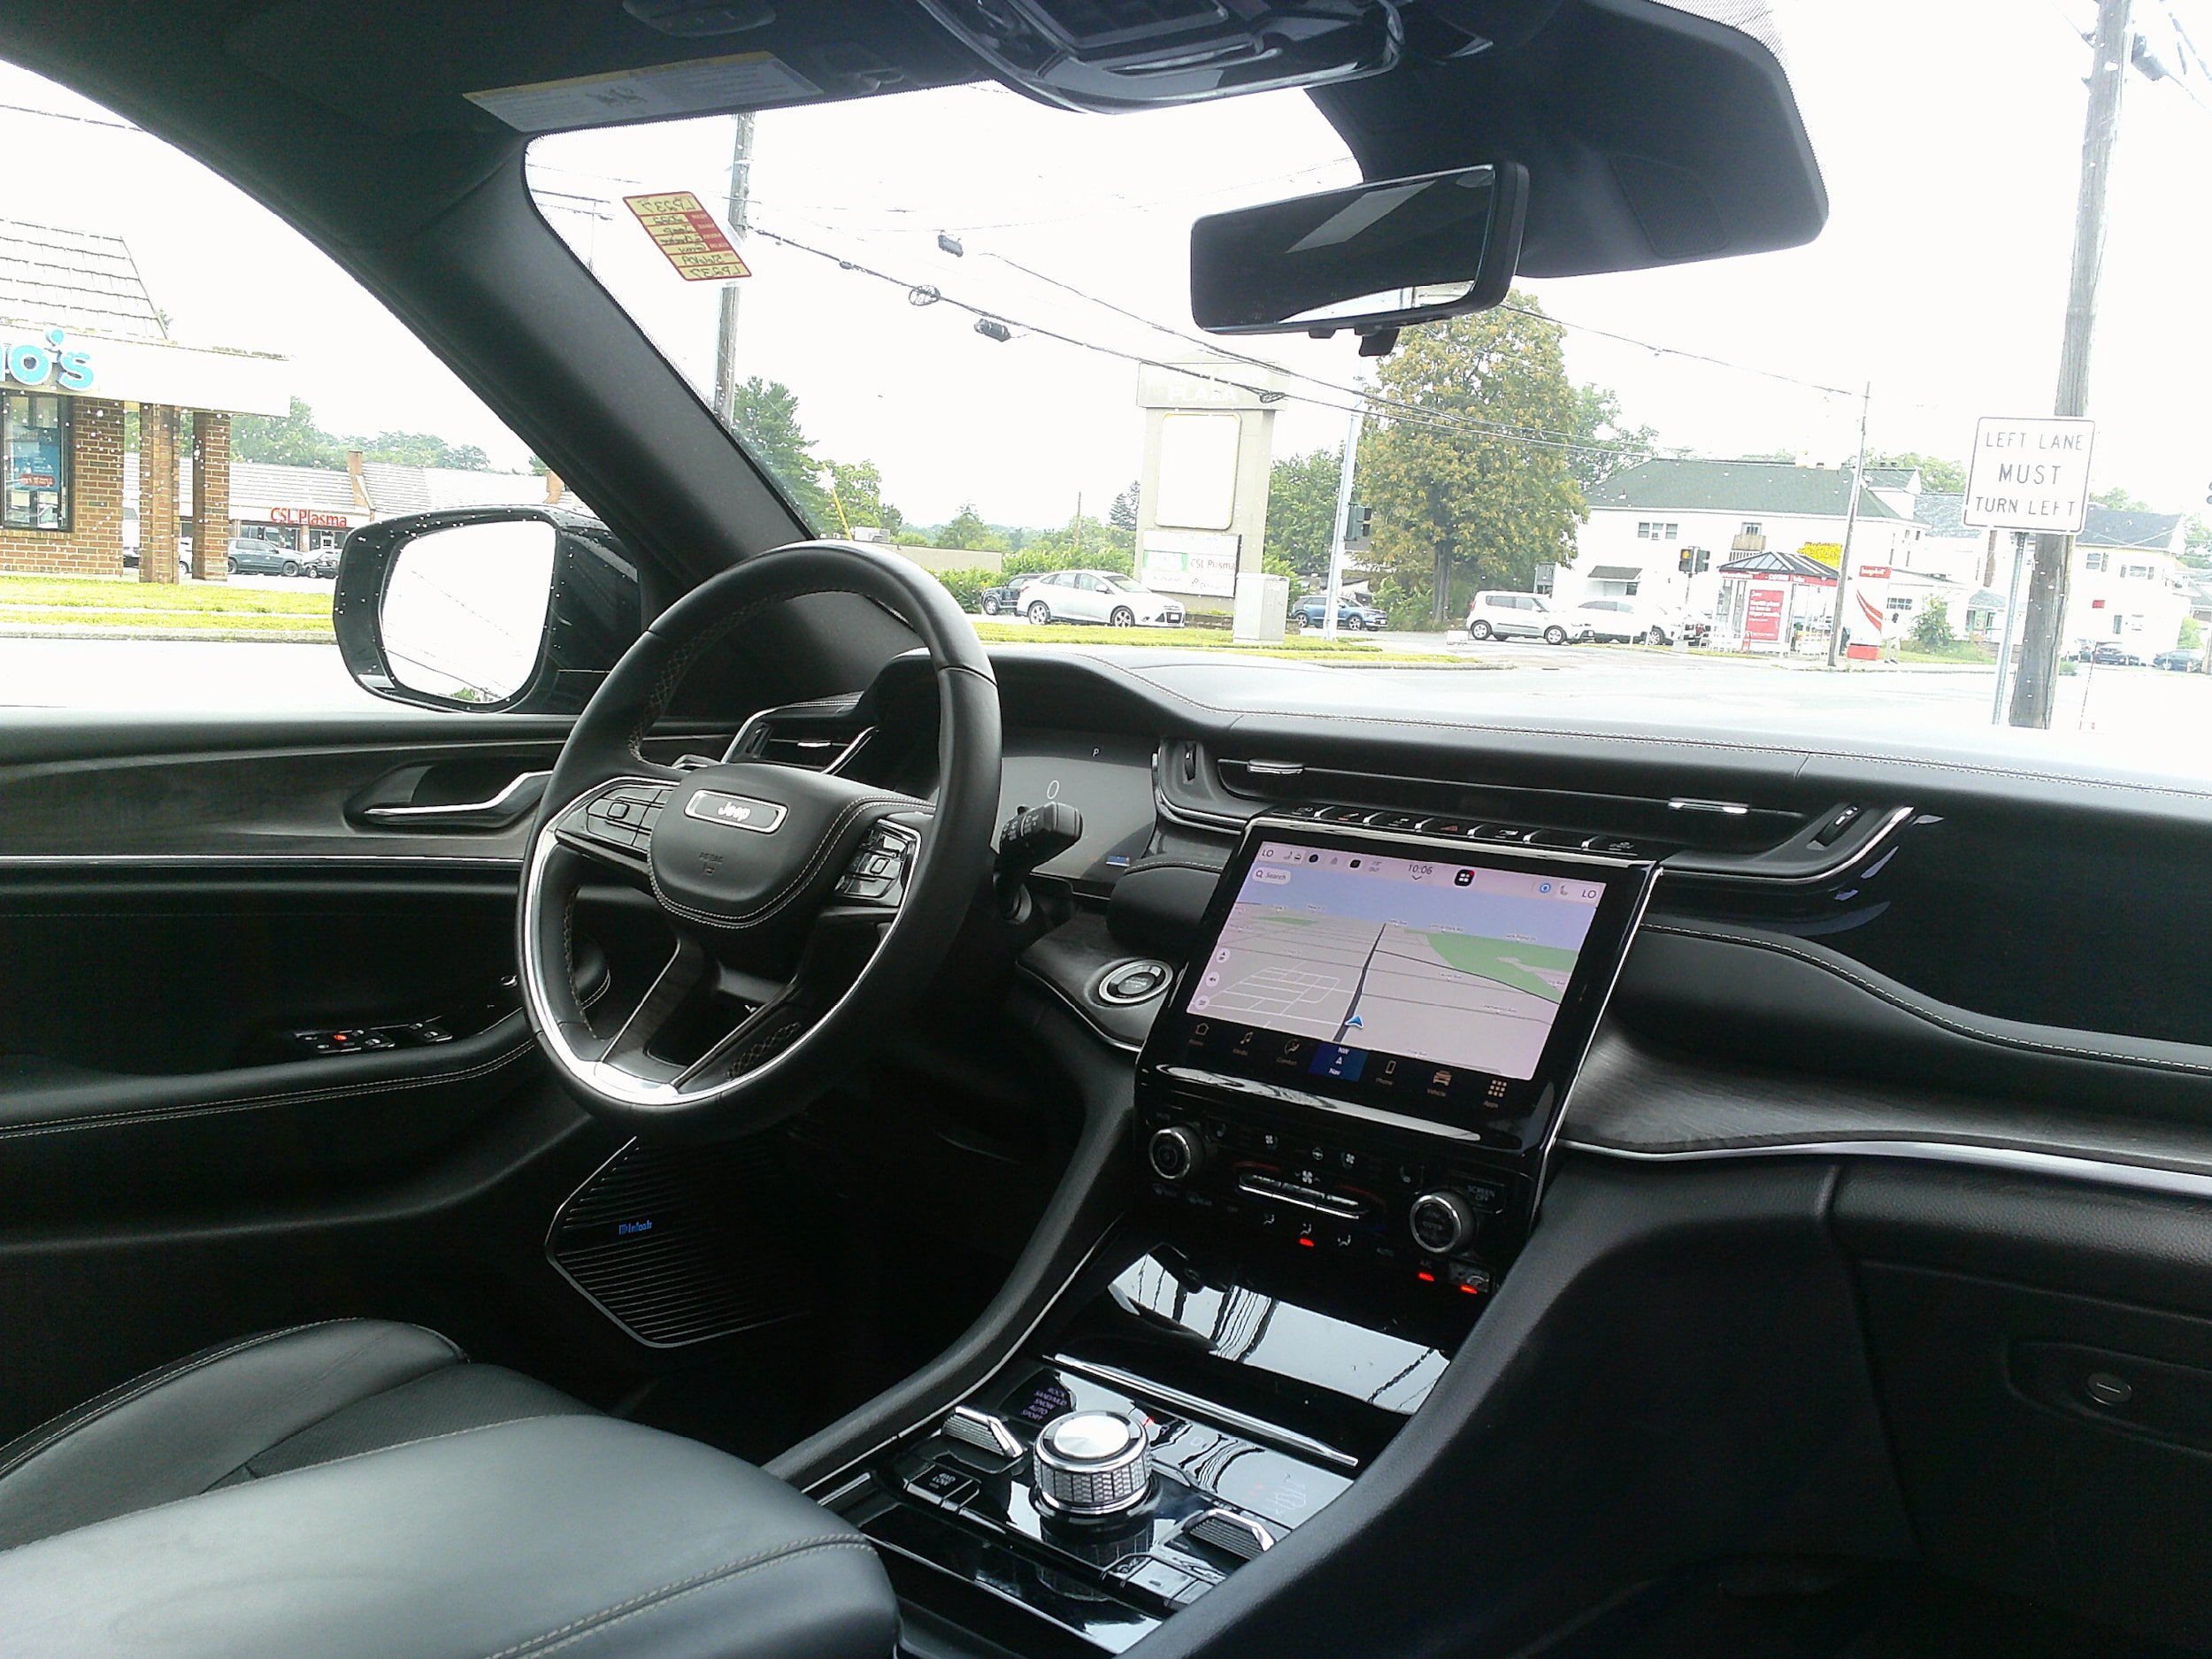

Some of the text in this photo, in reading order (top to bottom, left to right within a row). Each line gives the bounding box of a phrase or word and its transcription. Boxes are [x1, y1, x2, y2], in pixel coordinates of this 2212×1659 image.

[0, 328, 95, 391] o's
[1985, 432, 2085, 450] LEFT LANE
[1998, 463, 2062, 485] MUST
[1975, 496, 2077, 516] TURN LEFT
[270, 507, 348, 527] CSL Plasma
[718, 801, 751, 821] Jeep
[1261, 849, 1274, 857] LO
[1265, 872, 1286, 880] Search
[1581, 889, 1597, 899] LO
[1328, 1067, 1341, 1076] Nav
[1033, 1398, 1056, 1409] SNOW
[1020, 1409, 1043, 1421] SPORT
[1028, 1405, 1048, 1416] AUTO
